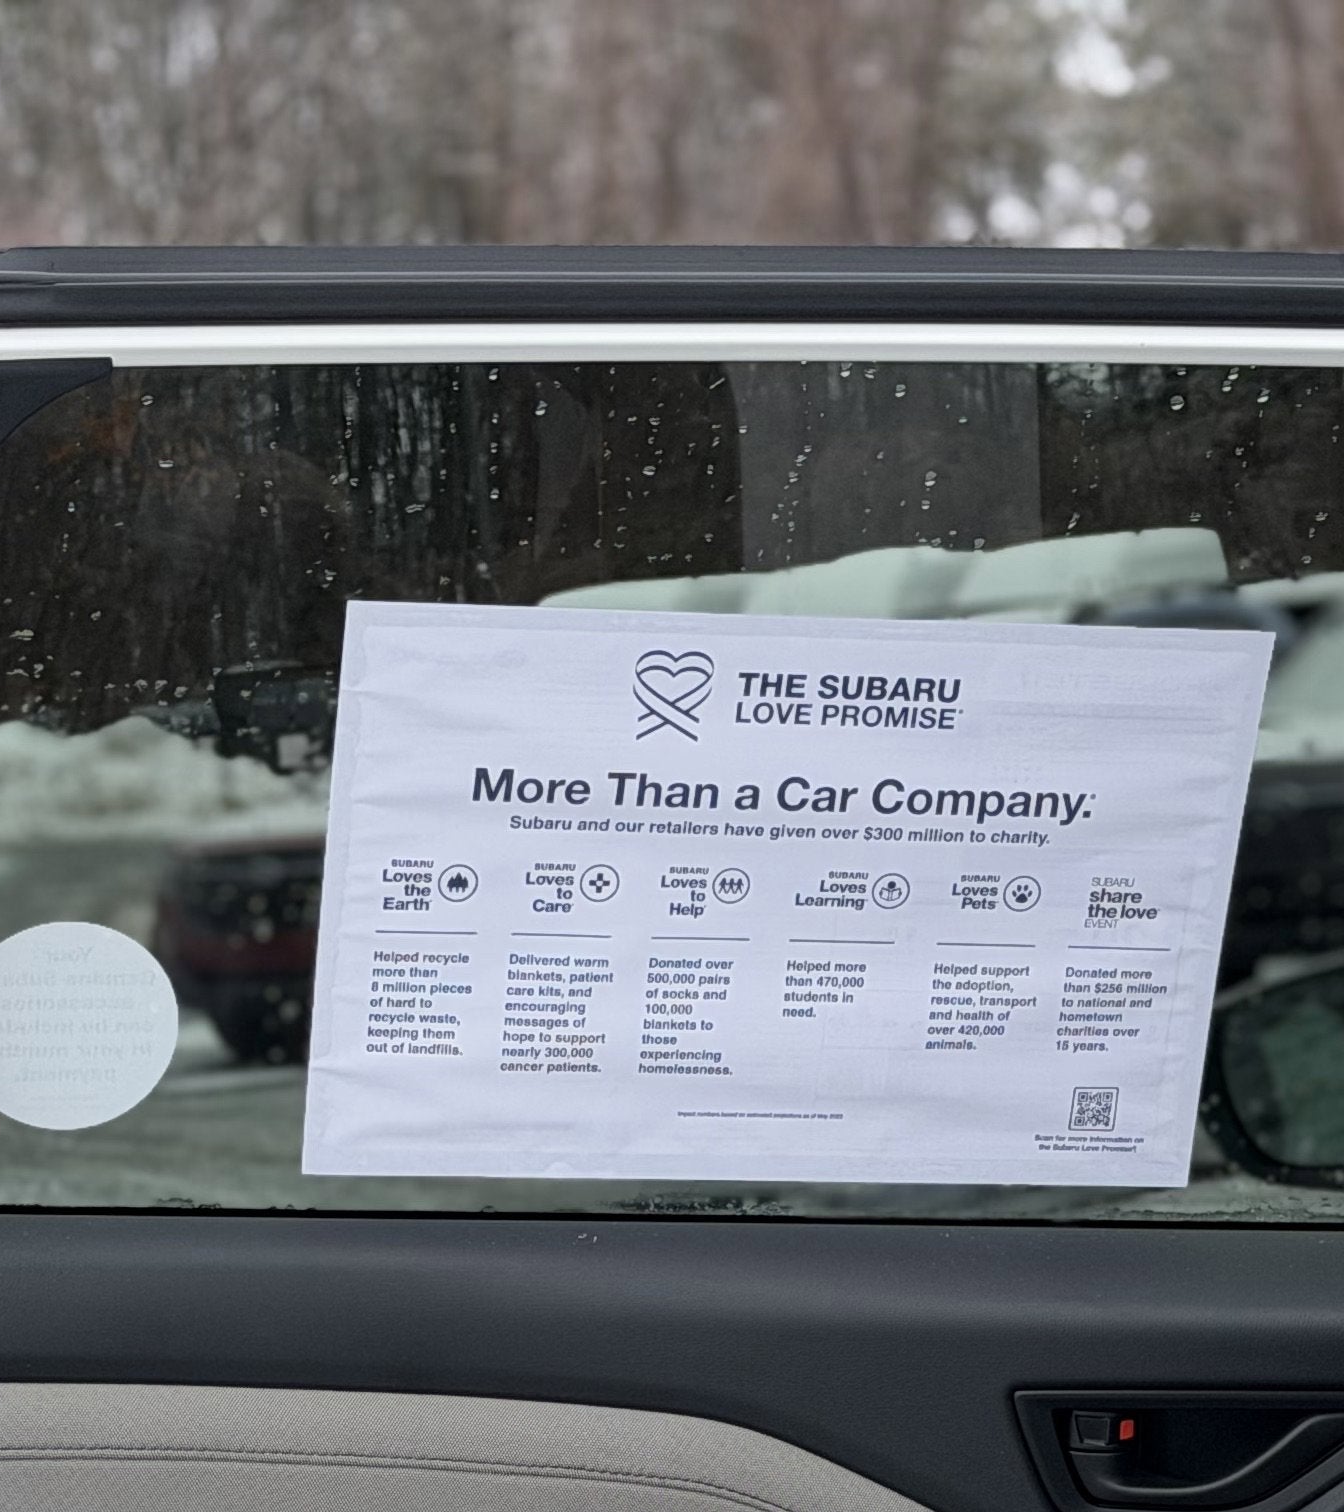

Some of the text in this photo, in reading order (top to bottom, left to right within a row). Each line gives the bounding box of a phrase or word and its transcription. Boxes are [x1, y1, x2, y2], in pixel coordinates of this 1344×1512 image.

[739, 672, 961, 703] THE SUBARU
[736, 702, 813, 725] LOVE
[473, 768, 590, 805] More
[608, 772, 719, 809] Than
[735, 785, 760, 810] a
[777, 777, 858, 812] Car
[510, 815, 1049, 847] Subaru and our retailers have given over $300 million to charity.
[391, 859, 434, 868] SUBARU
[535, 863, 576, 871] SUBARU
[383, 869, 432, 883] Loves
[669, 867, 709, 875] SUBARU
[829, 871, 869, 880] SUBARU
[526, 872, 574, 886] Loves
[661, 875, 707, 889] Loves
[1091, 877, 1135, 887] SUBARU
[404, 884, 431, 896] the
[557, 887, 573, 899] to
[820, 880, 866, 893] Loves
[952, 883, 998, 897] Loves
[691, 890, 706, 902] to
[795, 893, 864, 910] Learning
[1089, 888, 1142, 903] share
[383, 897, 432, 911] Earth
[533, 899, 574, 913] Care
[670, 902, 706, 919] Help
[960, 897, 997, 912] Pets
[1088, 904, 1157, 919] the love
[1084, 919, 1119, 928] EVENT
[374, 951, 469, 966] Helped recycle
[510, 954, 609, 968] Delivered warm
[649, 958, 734, 969] Donated over
[373, 967, 438, 978] more than
[787, 960, 866, 974] Helped more
[934, 963, 1029, 978] Helped support
[1066, 967, 1152, 979] Donated more
[508, 969, 613, 984] blankets, patient
[647, 973, 730, 987] 500,000 pairs
[786, 976, 864, 989] than 470,000
[371, 981, 472, 996] 8 million pieces
[507, 986, 592, 999] care kits, and
[933, 979, 1014, 993] the adoption,
[1064, 982, 1167, 994] than $256 million
[646, 988, 727, 1000] of socks and
[784, 991, 853, 1003] students in
[370, 997, 432, 1008] of hard to
[505, 1001, 586, 1015] encouraging
[931, 996, 1037, 1009] rescue, transport
[1062, 997, 1152, 1008] to national and
[645, 1004, 693, 1016] 100,000
[783, 1007, 816, 1017] need.
[929, 1009, 1011, 1021] and health of
[1059, 1011, 1122, 1022] hometown
[369, 1012, 460, 1026] recycle waste,
[504, 1017, 586, 1030] messages of
[643, 1019, 713, 1030] blankets to
[368, 1026, 455, 1041] keeping them
[927, 1025, 1005, 1037] over 420,000
[1057, 1026, 1140, 1037] charities over
[503, 1030, 605, 1046] hope to support
[642, 1034, 677, 1045] those
[925, 1039, 976, 1050] animals.
[366, 1042, 463, 1055] out of landfills.
[1056, 1040, 1108, 1053] 15 years.
[502, 1047, 593, 1060] nearly 300,000
[640, 1049, 722, 1063] experiencing
[500, 1062, 601, 1074] cancer patients.
[638, 1063, 733, 1075] homelessness.
